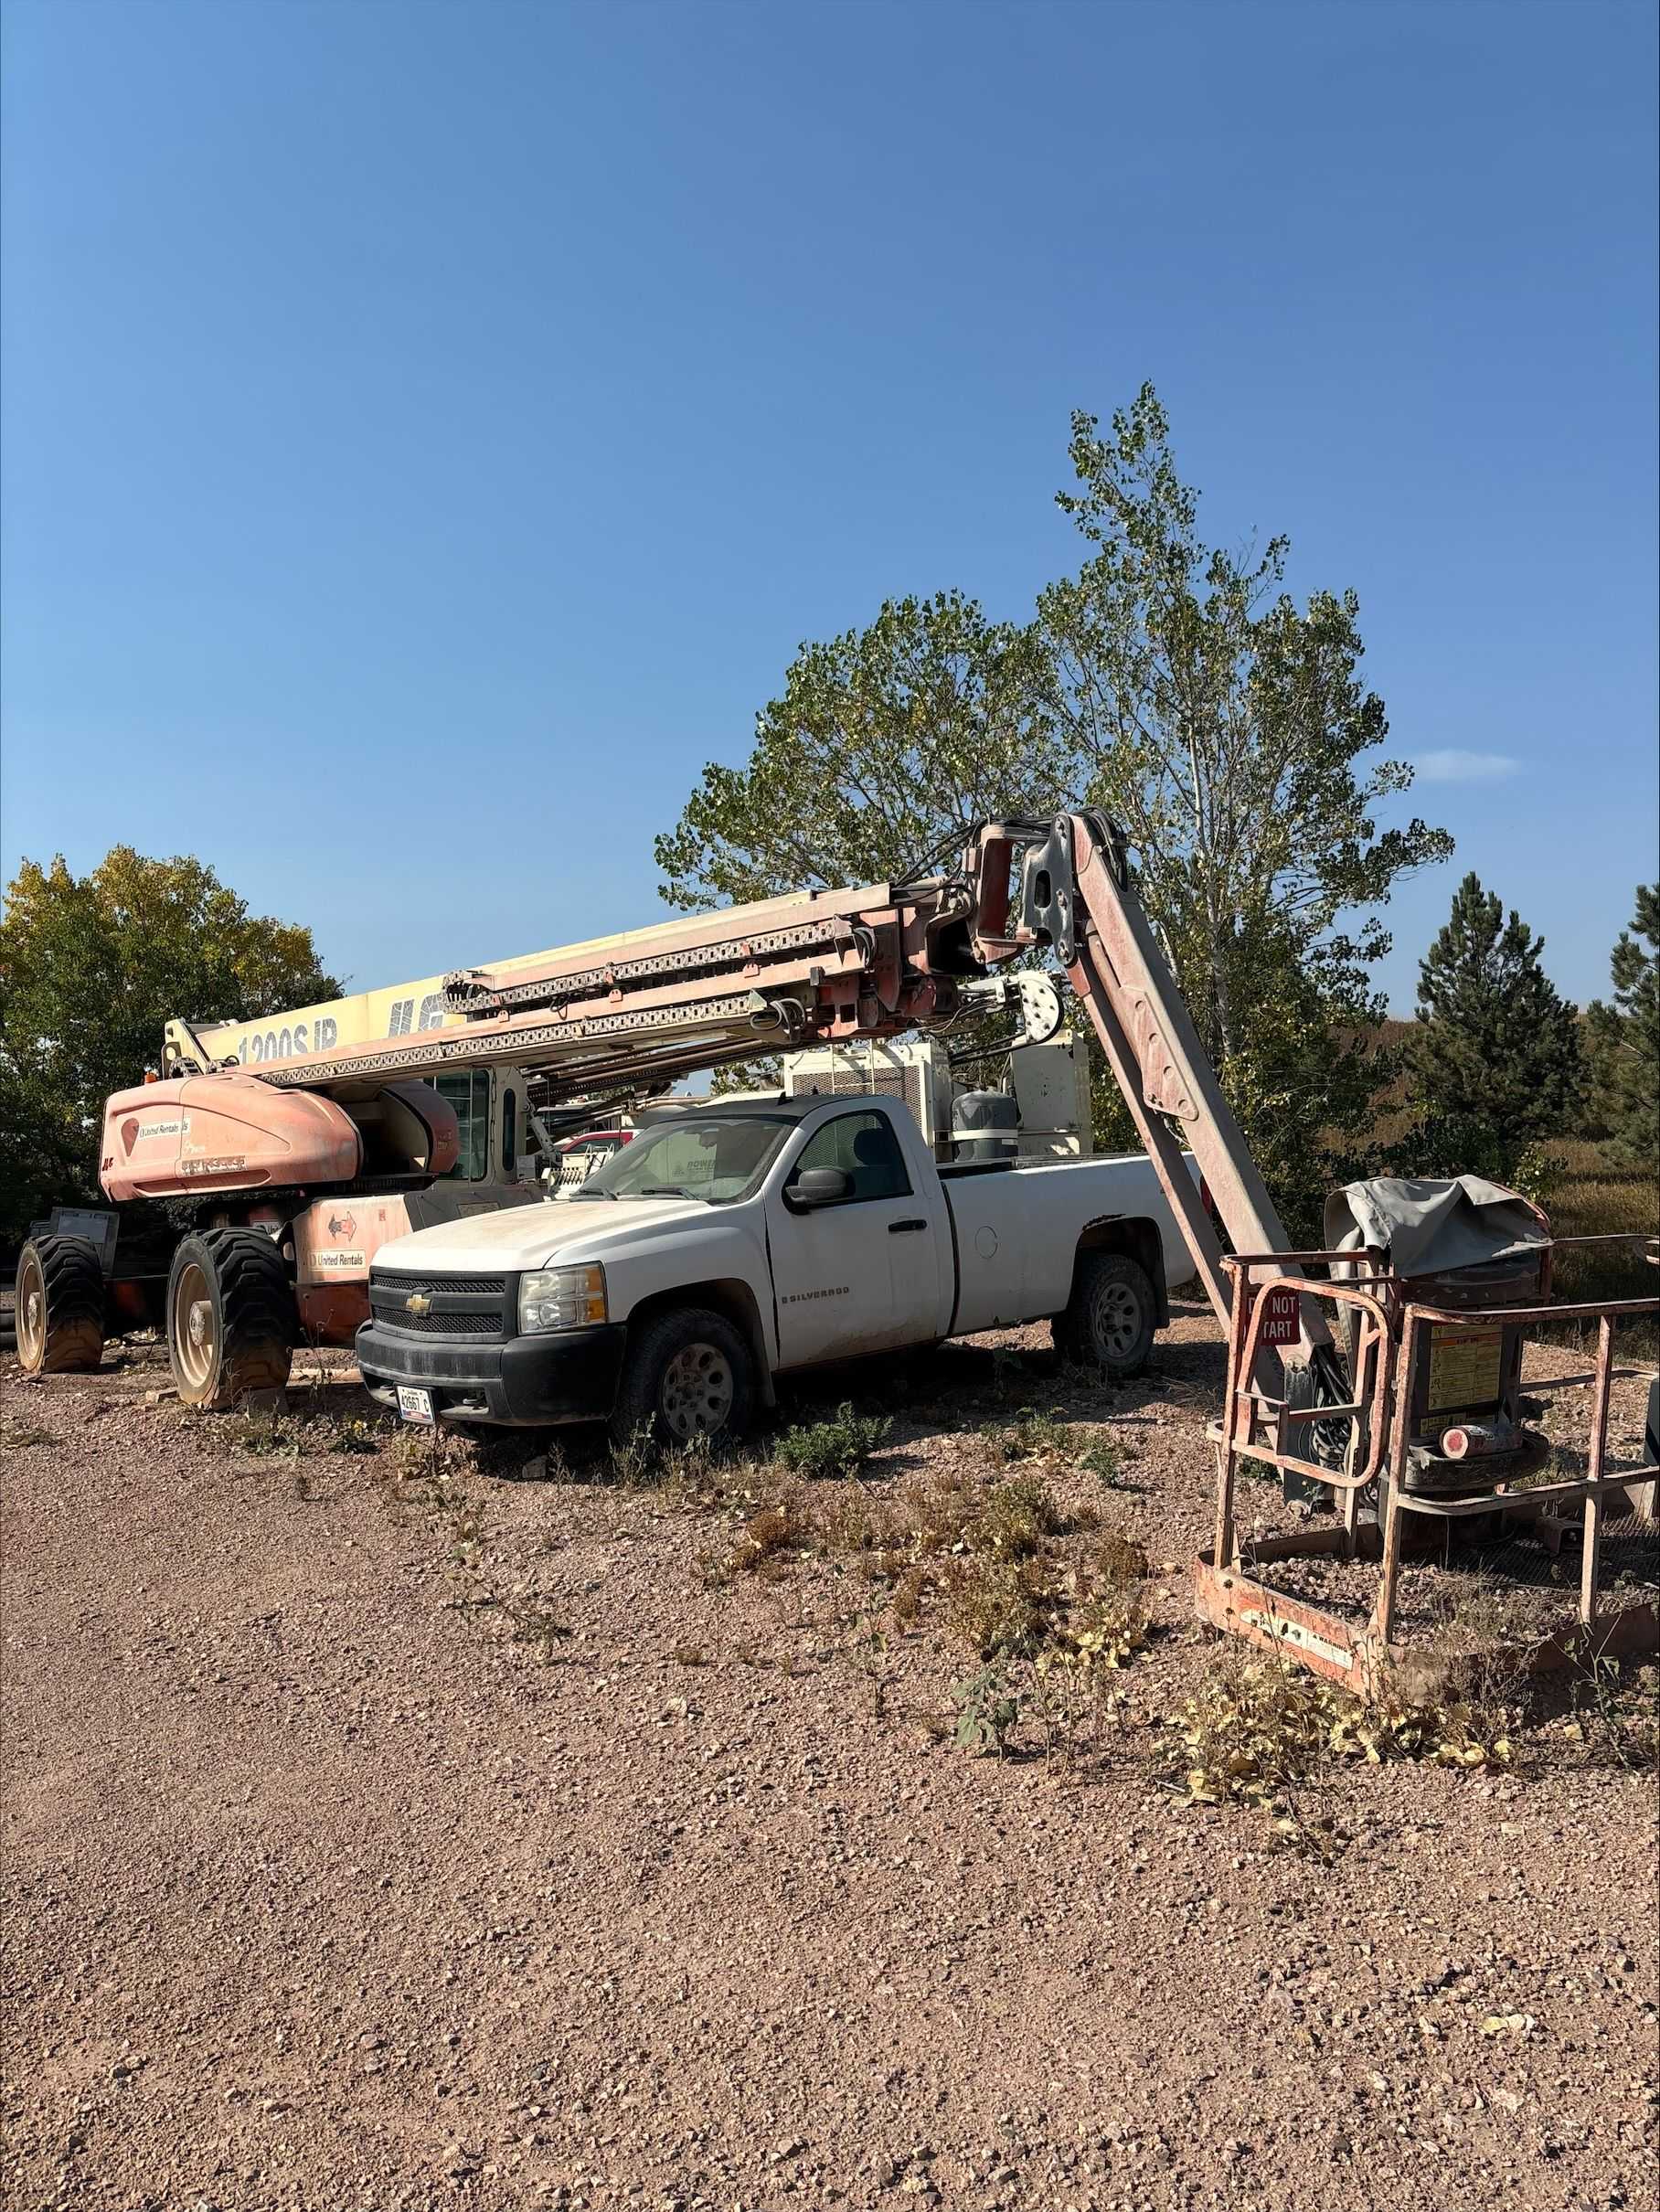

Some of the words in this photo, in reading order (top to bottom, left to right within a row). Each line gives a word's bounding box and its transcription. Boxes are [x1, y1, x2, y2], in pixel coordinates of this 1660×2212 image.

[317, 1253, 338, 1266] United
[340, 1253, 364, 1266] Rentals
[789, 1286, 849, 1303] SILVERADO
[1272, 1296, 1296, 1314] NOT
[1319, 1635, 1348, 1653] WARNING
